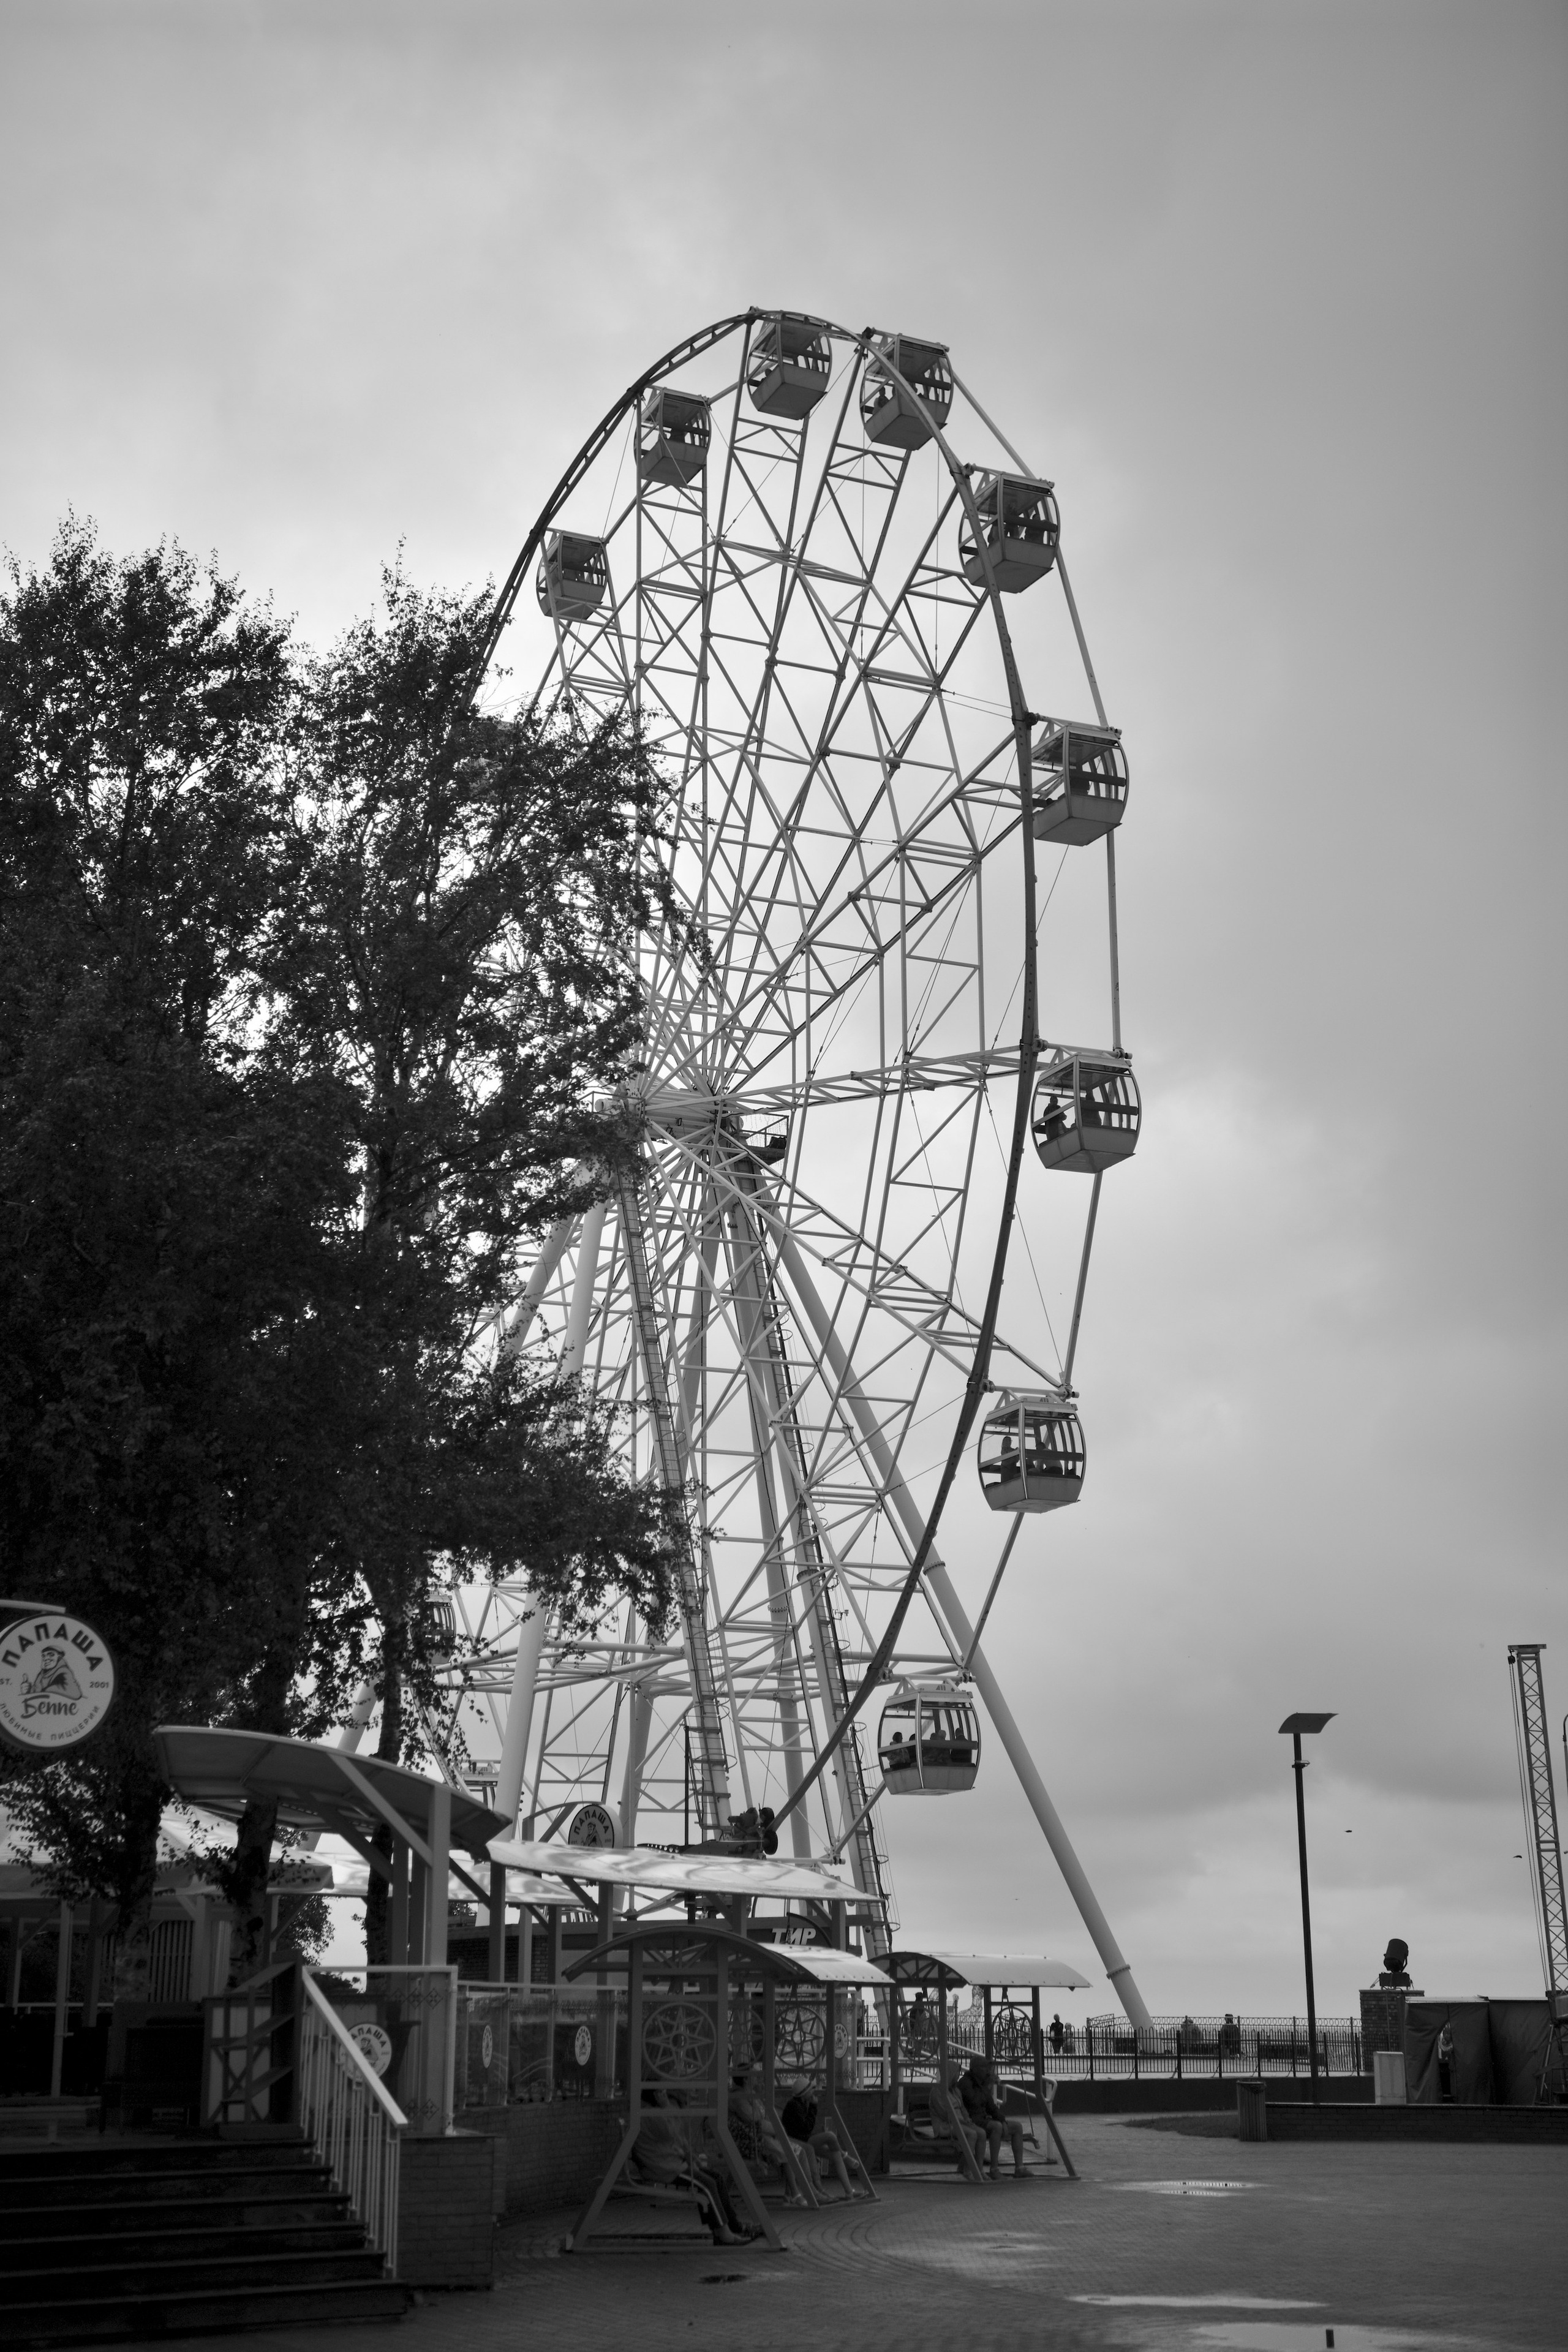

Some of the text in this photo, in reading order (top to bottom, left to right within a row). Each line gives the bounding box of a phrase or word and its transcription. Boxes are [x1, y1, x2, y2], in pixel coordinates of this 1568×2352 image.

[2, 1623, 103, 1672] ПАПАША
[21, 1694, 79, 1719] Беппе
[0, 1703, 99, 1741] ЛЮБИМЫЕ ПИЦЦЕРИИ
[574, 1810, 609, 1834] ПАПАША
[772, 1928, 816, 1945] ТИР
[351, 2028, 386, 2048] АПАША
